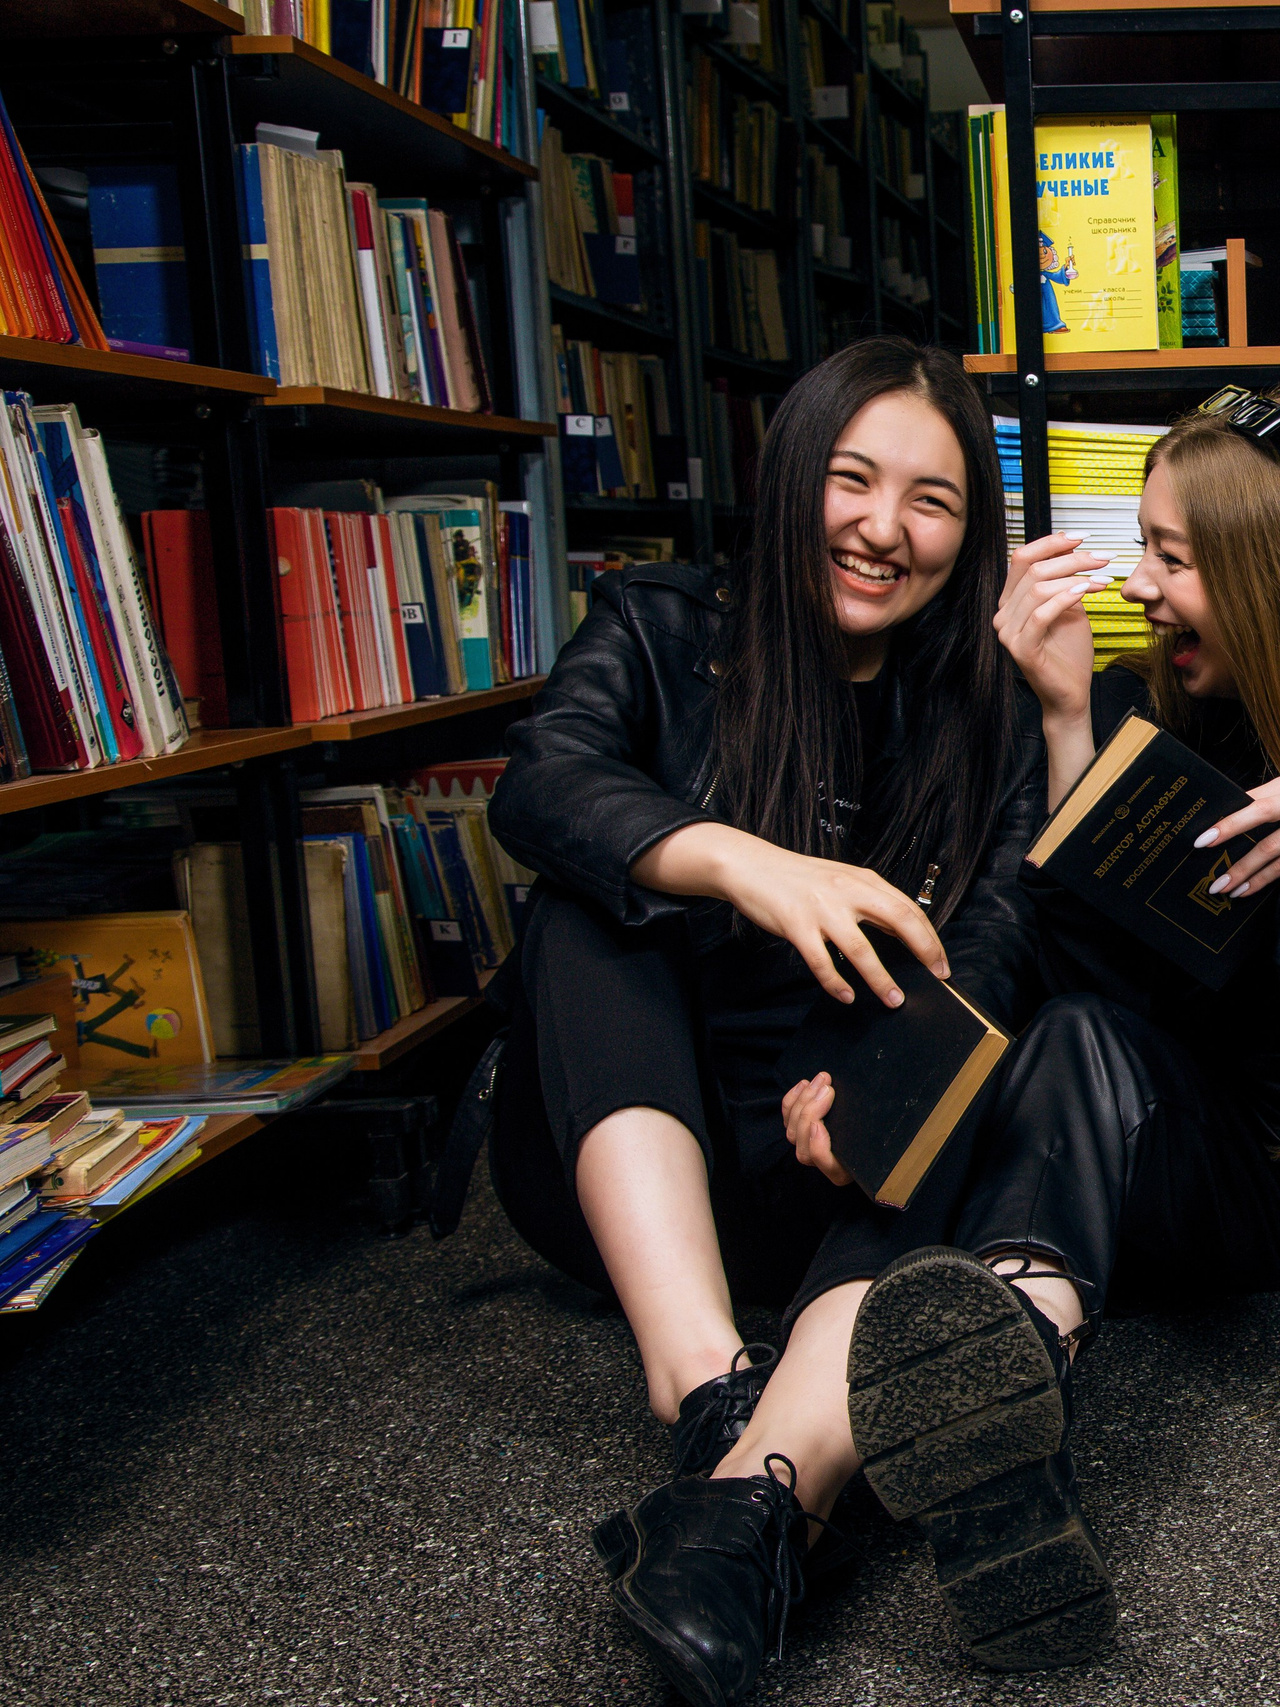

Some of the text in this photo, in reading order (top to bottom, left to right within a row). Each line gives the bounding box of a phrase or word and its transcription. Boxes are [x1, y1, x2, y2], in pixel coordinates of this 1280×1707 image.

[1153, 137, 1166, 158] А
[1036, 178, 1110, 198] УЧЕНЫЕ
[1087, 216, 1137, 226] Справочник
[1091, 226, 1137, 235] школьника
[1093, 775, 1189, 879] ВИКТОР АСТАФЬЕВ
[1139, 819, 1172, 853] КРАЖА
[1122, 797, 1207, 889] ПОСЛЕДНИЙ ПОКЛОН
